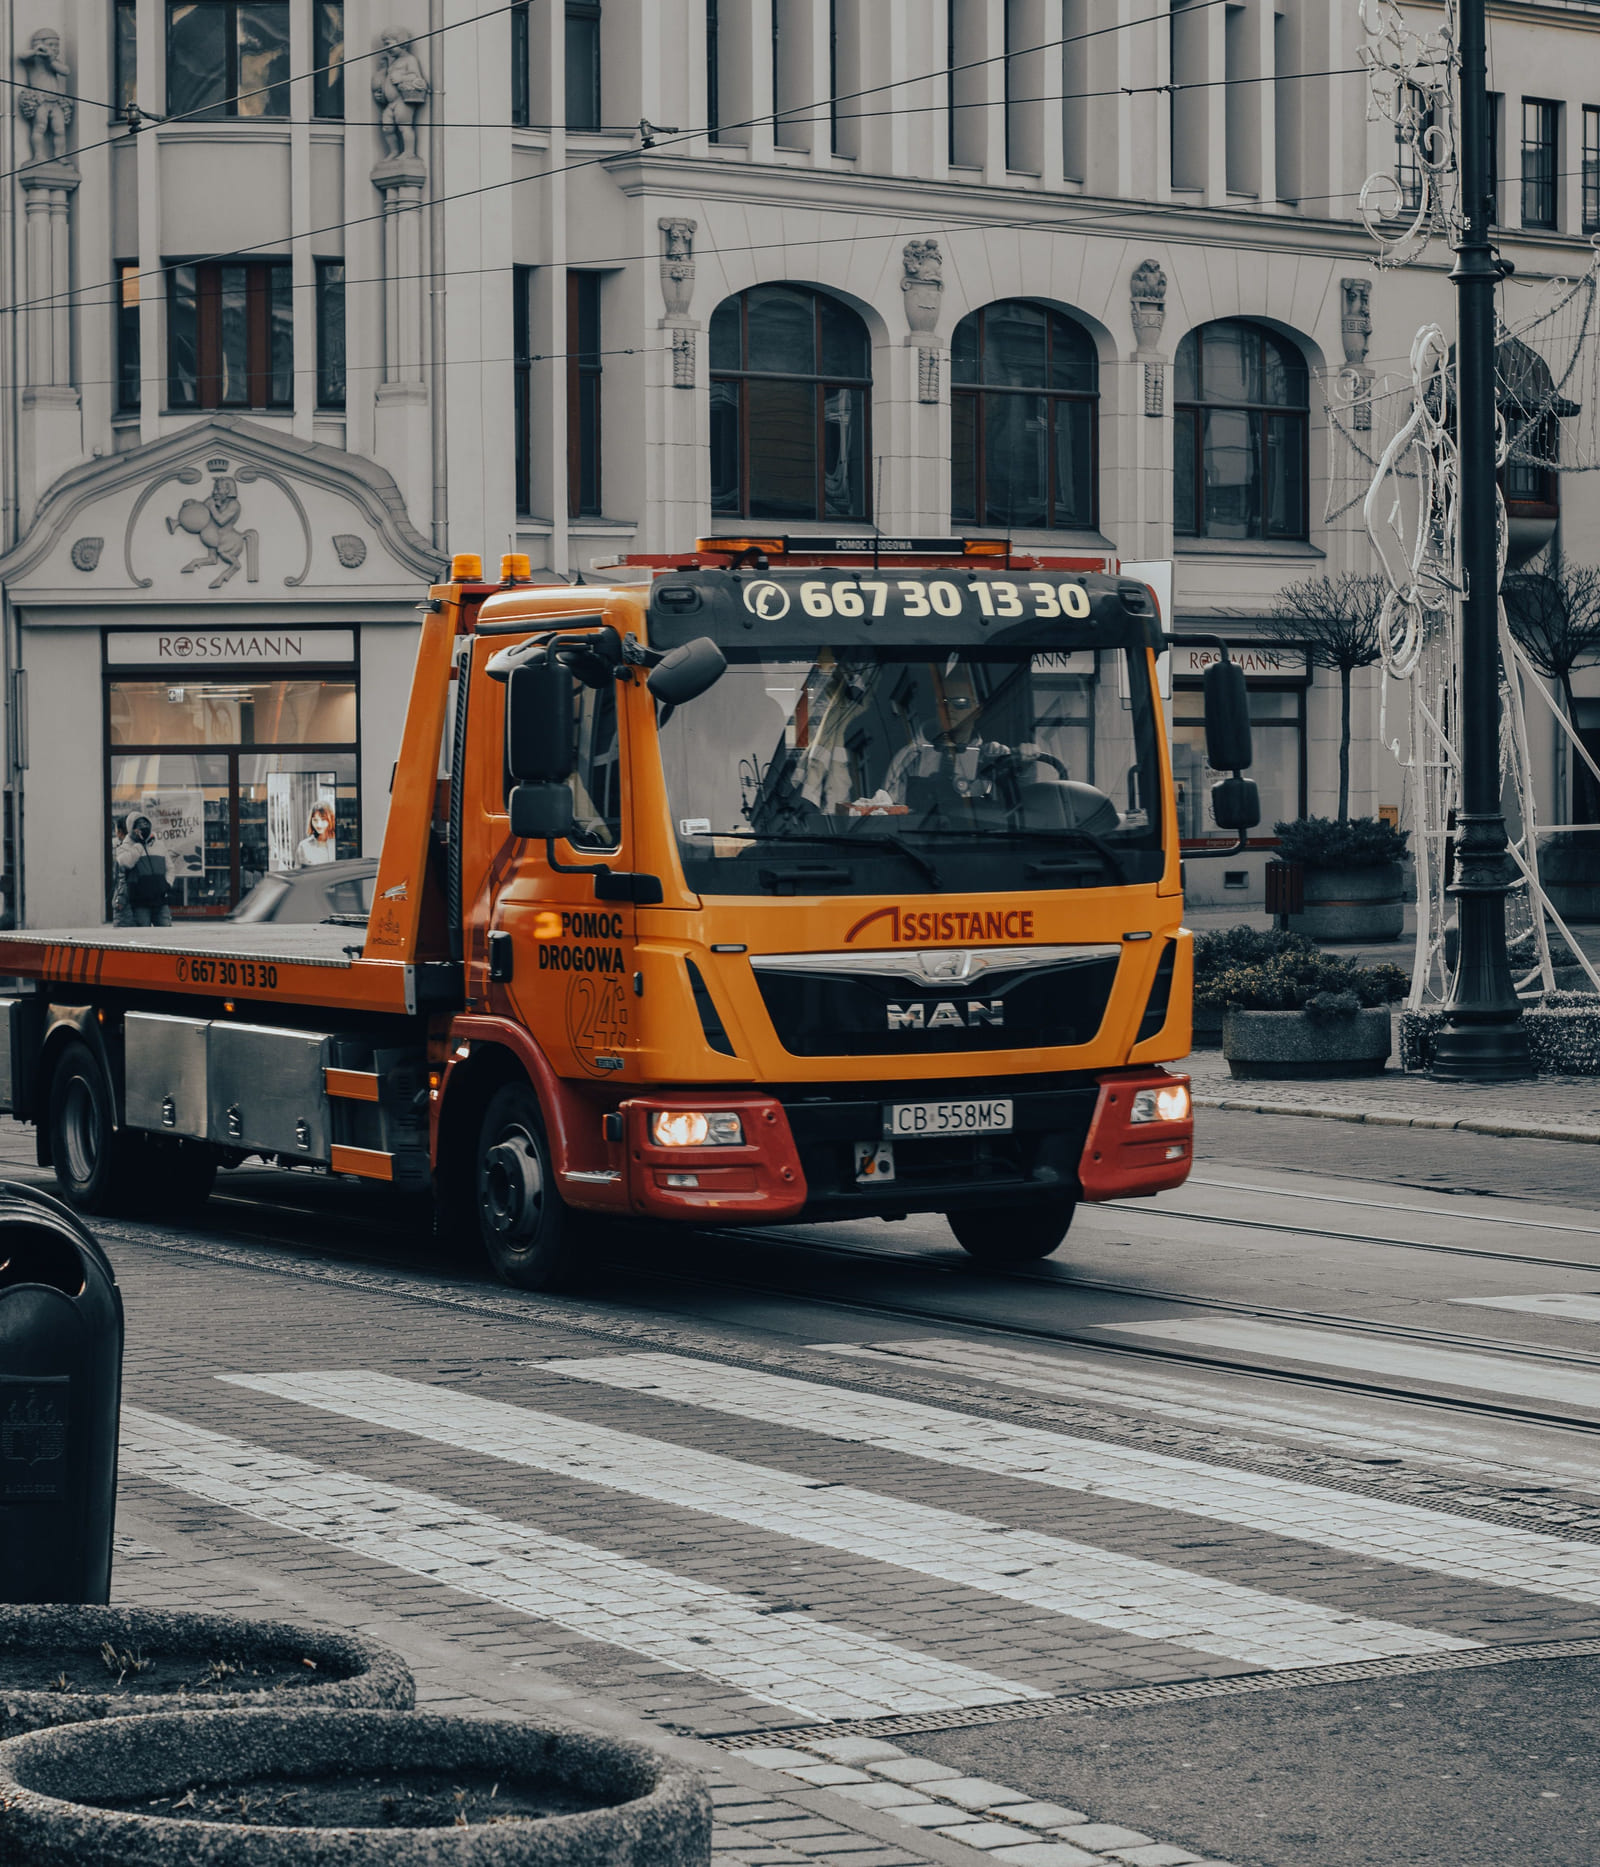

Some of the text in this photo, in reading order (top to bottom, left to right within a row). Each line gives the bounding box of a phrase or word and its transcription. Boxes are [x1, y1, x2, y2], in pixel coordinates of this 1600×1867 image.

[835, 540, 867, 549] POMOC
[800, 581, 1091, 619] 667 30 13 30
[158, 636, 303, 658] ROSSMANN
[560, 911, 624, 940] POMOC
[843, 906, 1035, 943] ASSISTANCE
[539, 944, 626, 973] DROGOWA
[191, 959, 278, 989] 667 30 13 30
[886, 1000, 1004, 1030] MAN
[898, 1102, 1007, 1131] CB 558MS
